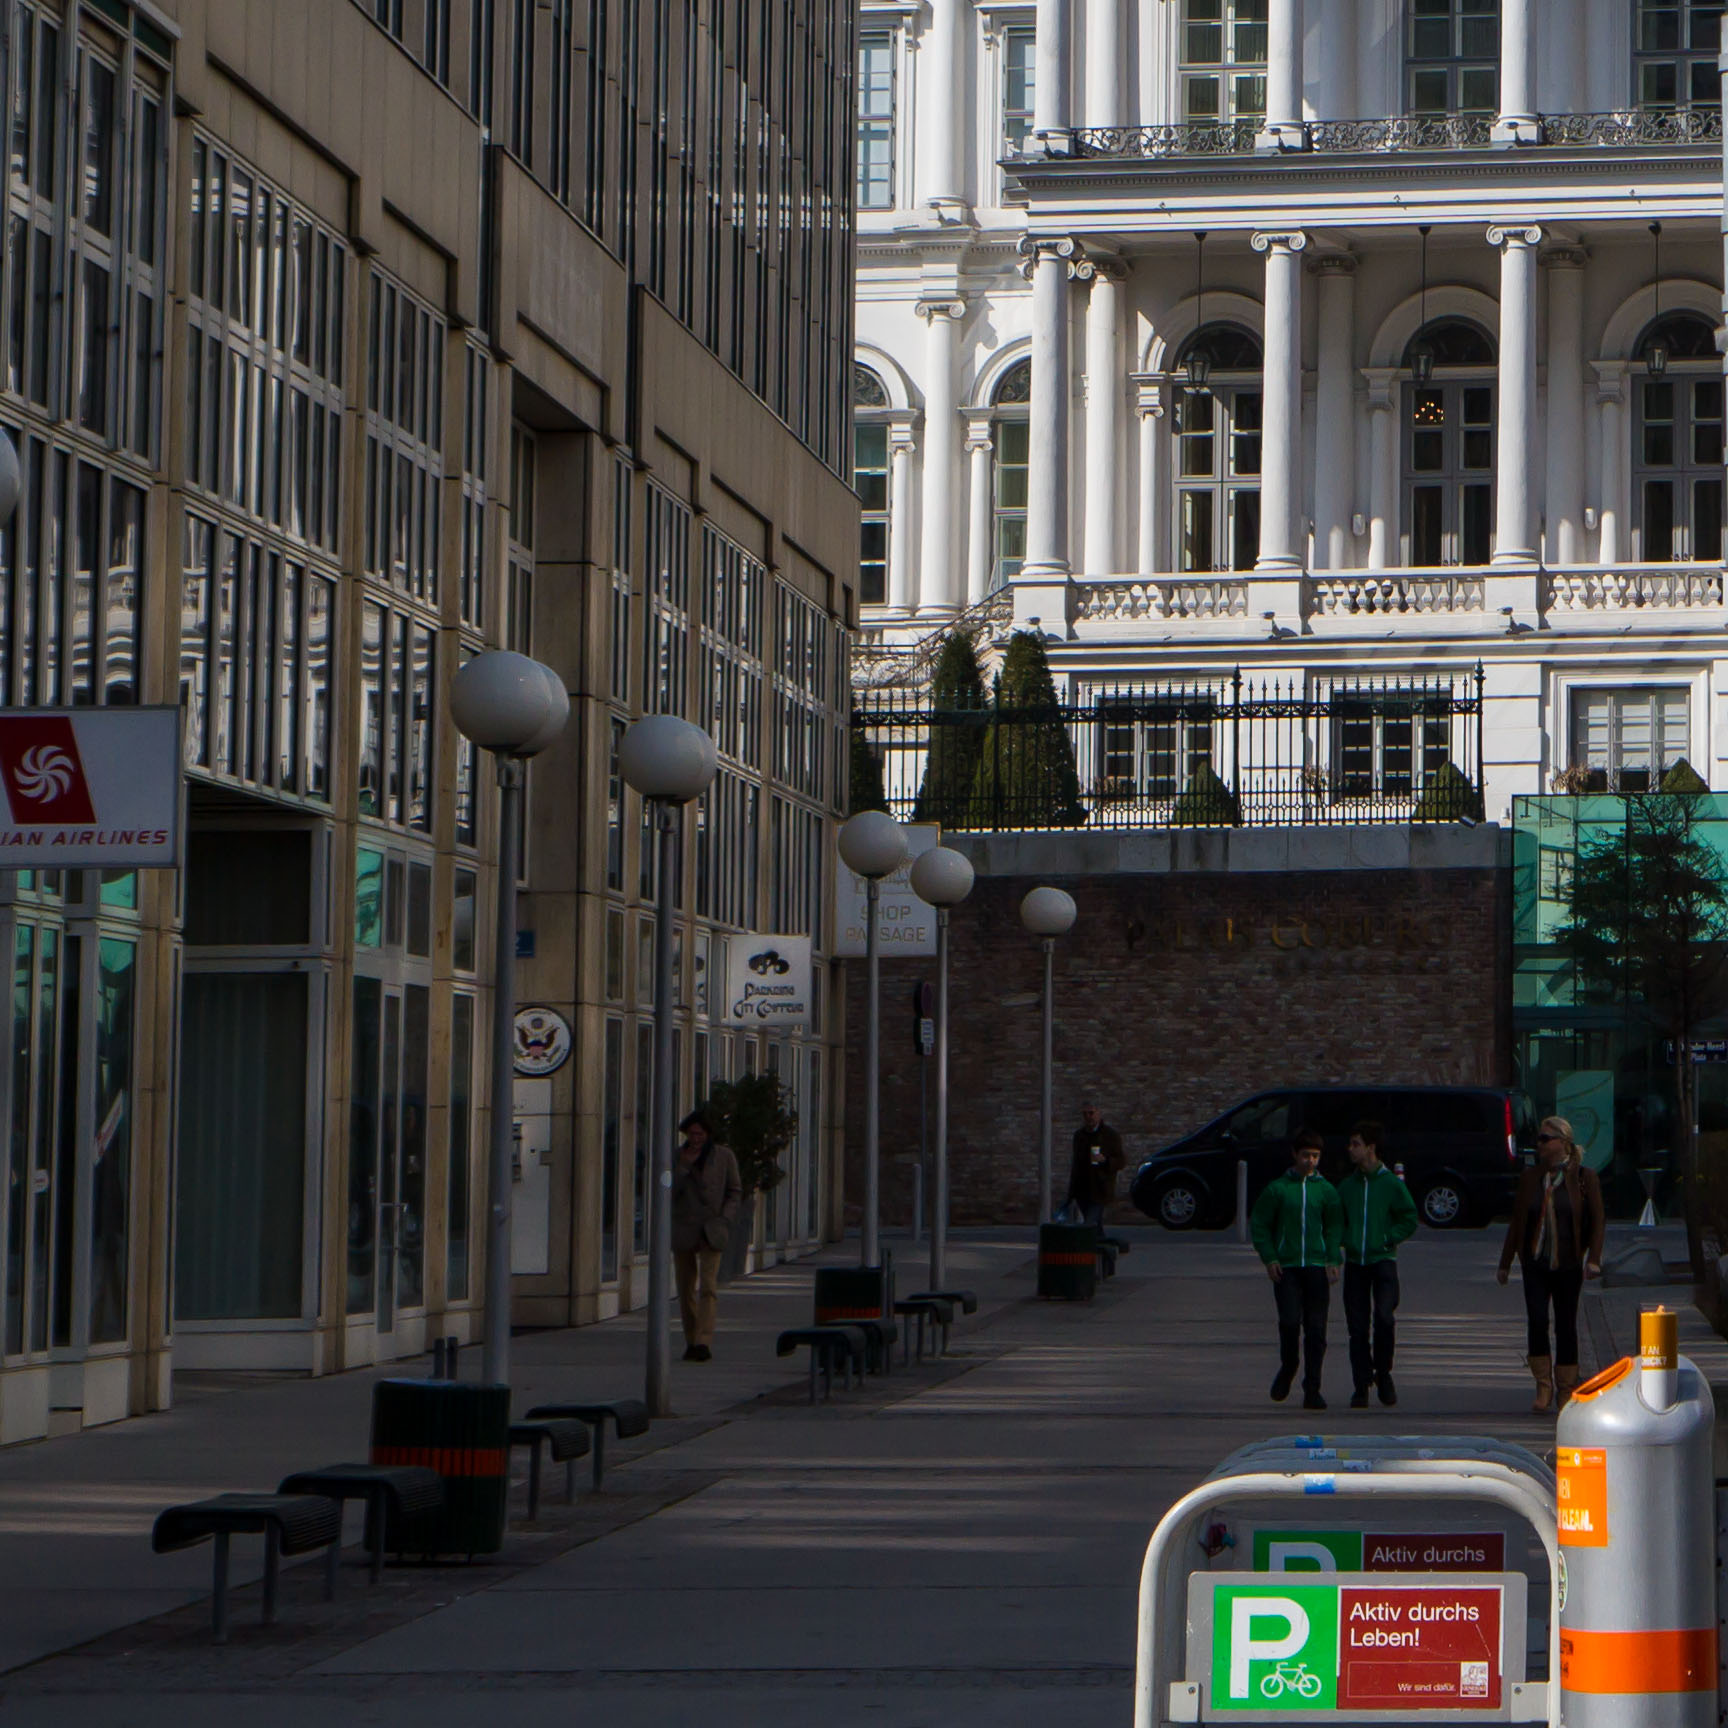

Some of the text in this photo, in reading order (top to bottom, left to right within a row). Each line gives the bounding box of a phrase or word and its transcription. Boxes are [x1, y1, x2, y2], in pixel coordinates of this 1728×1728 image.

[51, 830, 168, 846] AIRLINES
[846, 927, 926, 942] PASAGE
[1372, 1546, 1485, 1564] Aktiv durchs
[1350, 1602, 1479, 1622] Aktiv durchs
[1350, 1627, 1420, 1647] Leben!
